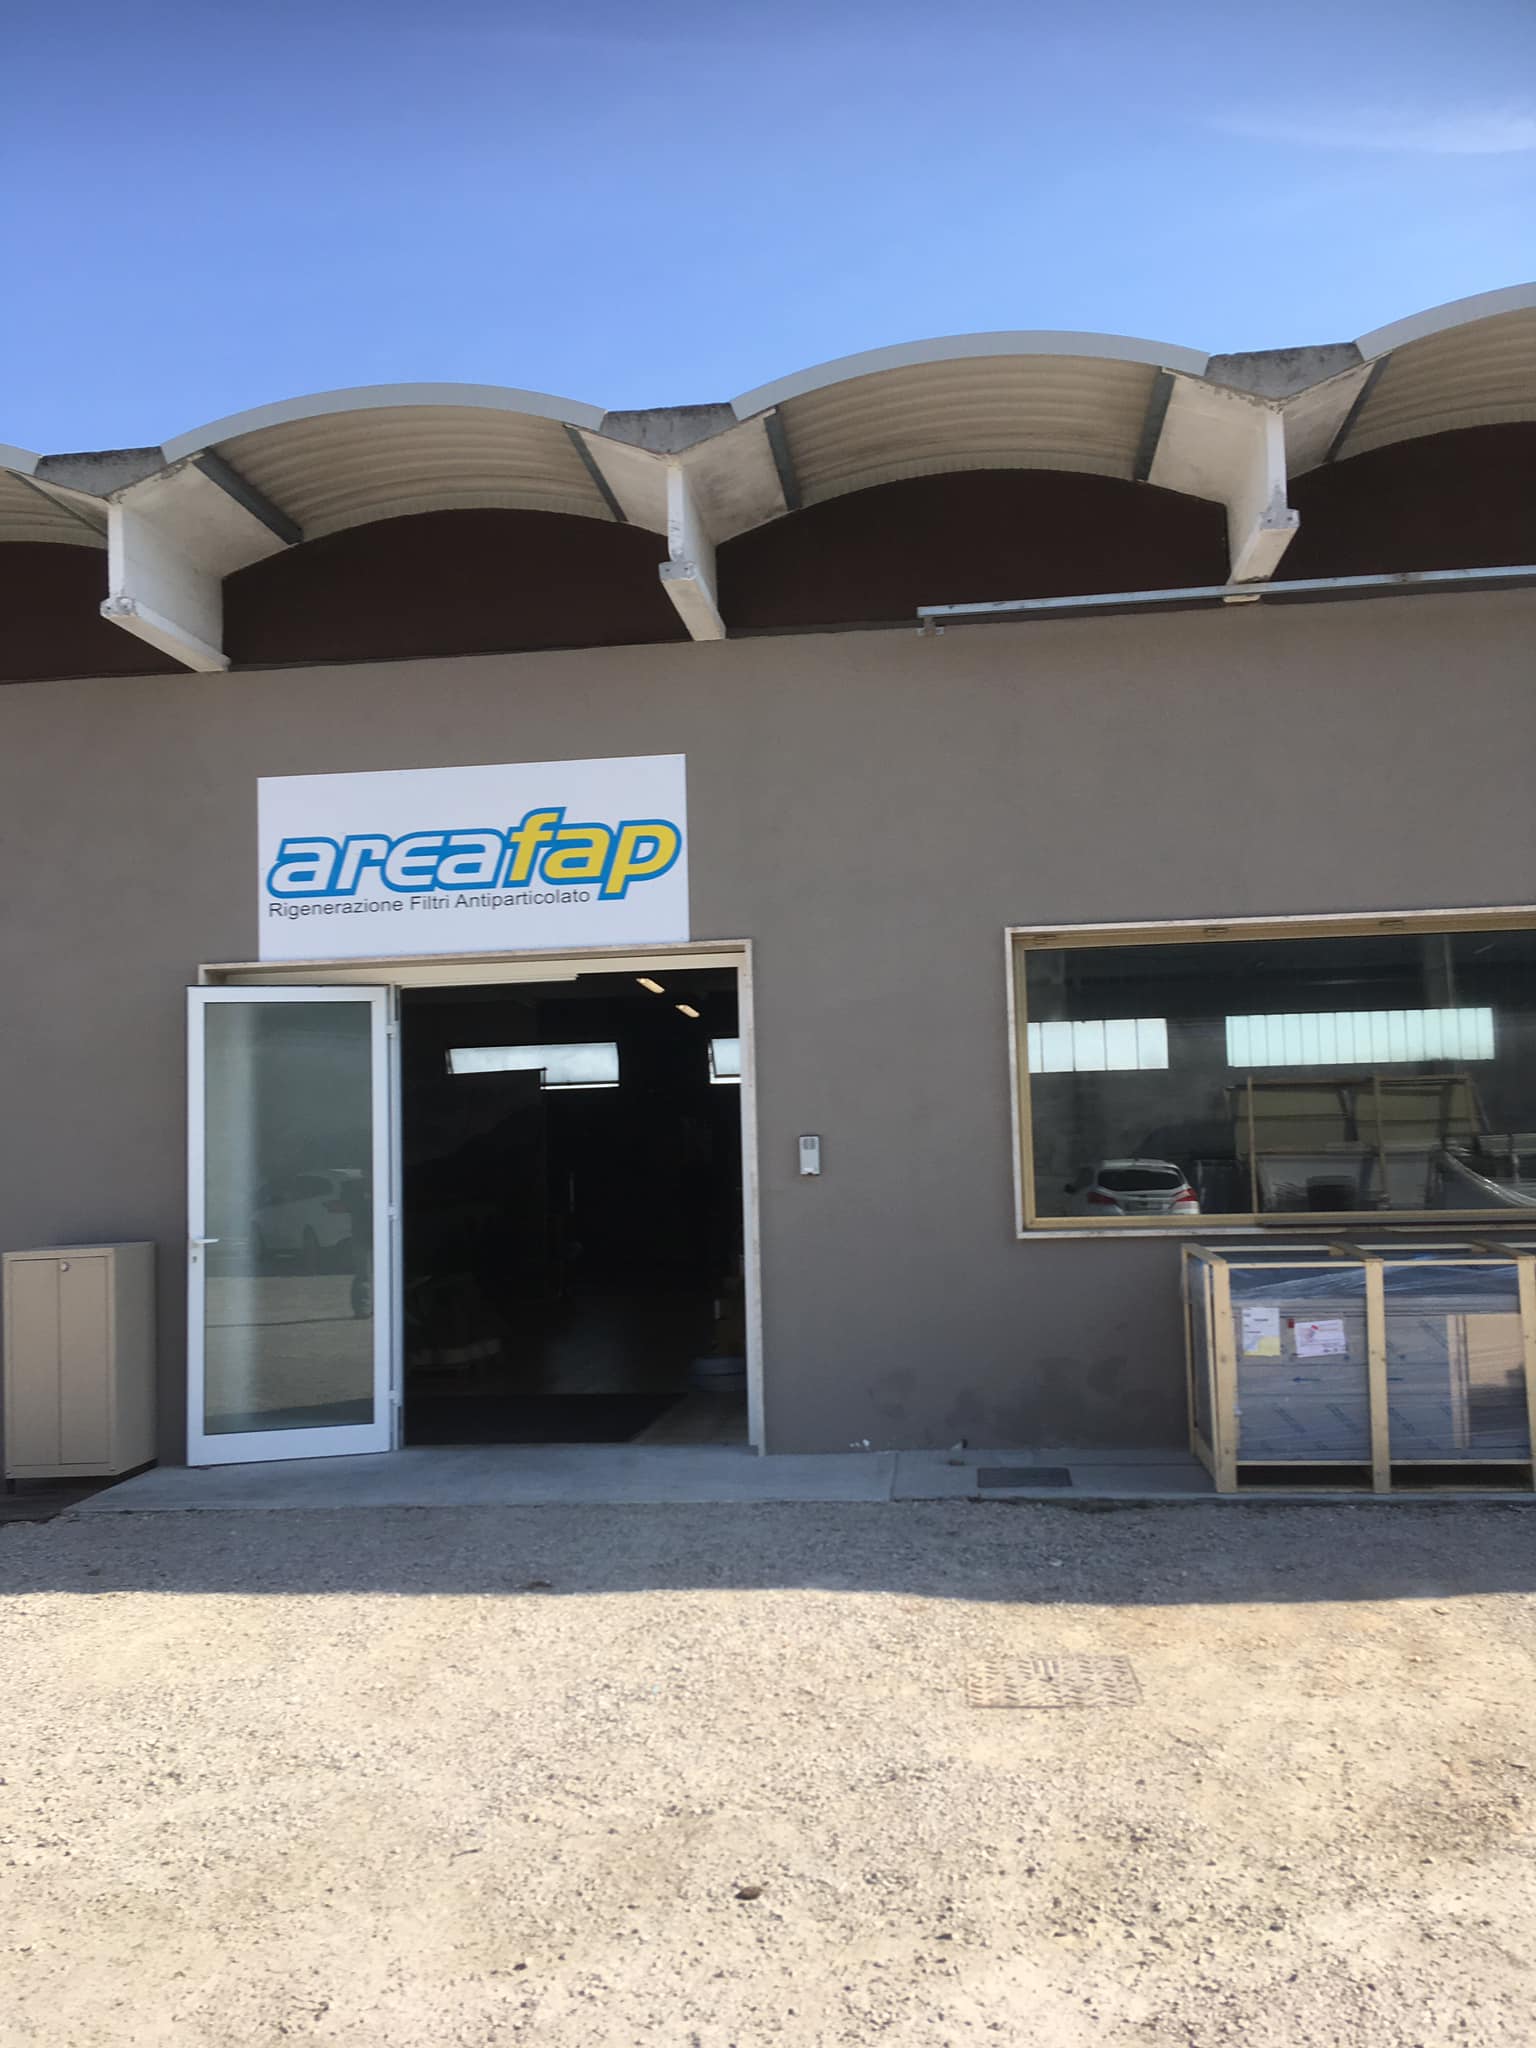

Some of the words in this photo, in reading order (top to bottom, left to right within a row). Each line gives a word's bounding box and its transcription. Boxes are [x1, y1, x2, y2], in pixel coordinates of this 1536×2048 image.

[267, 806, 682, 900] areafap
[268, 899, 404, 919] Rigenerazione
[410, 895, 449, 910] Filtri
[455, 889, 591, 909] Antiparticolato
